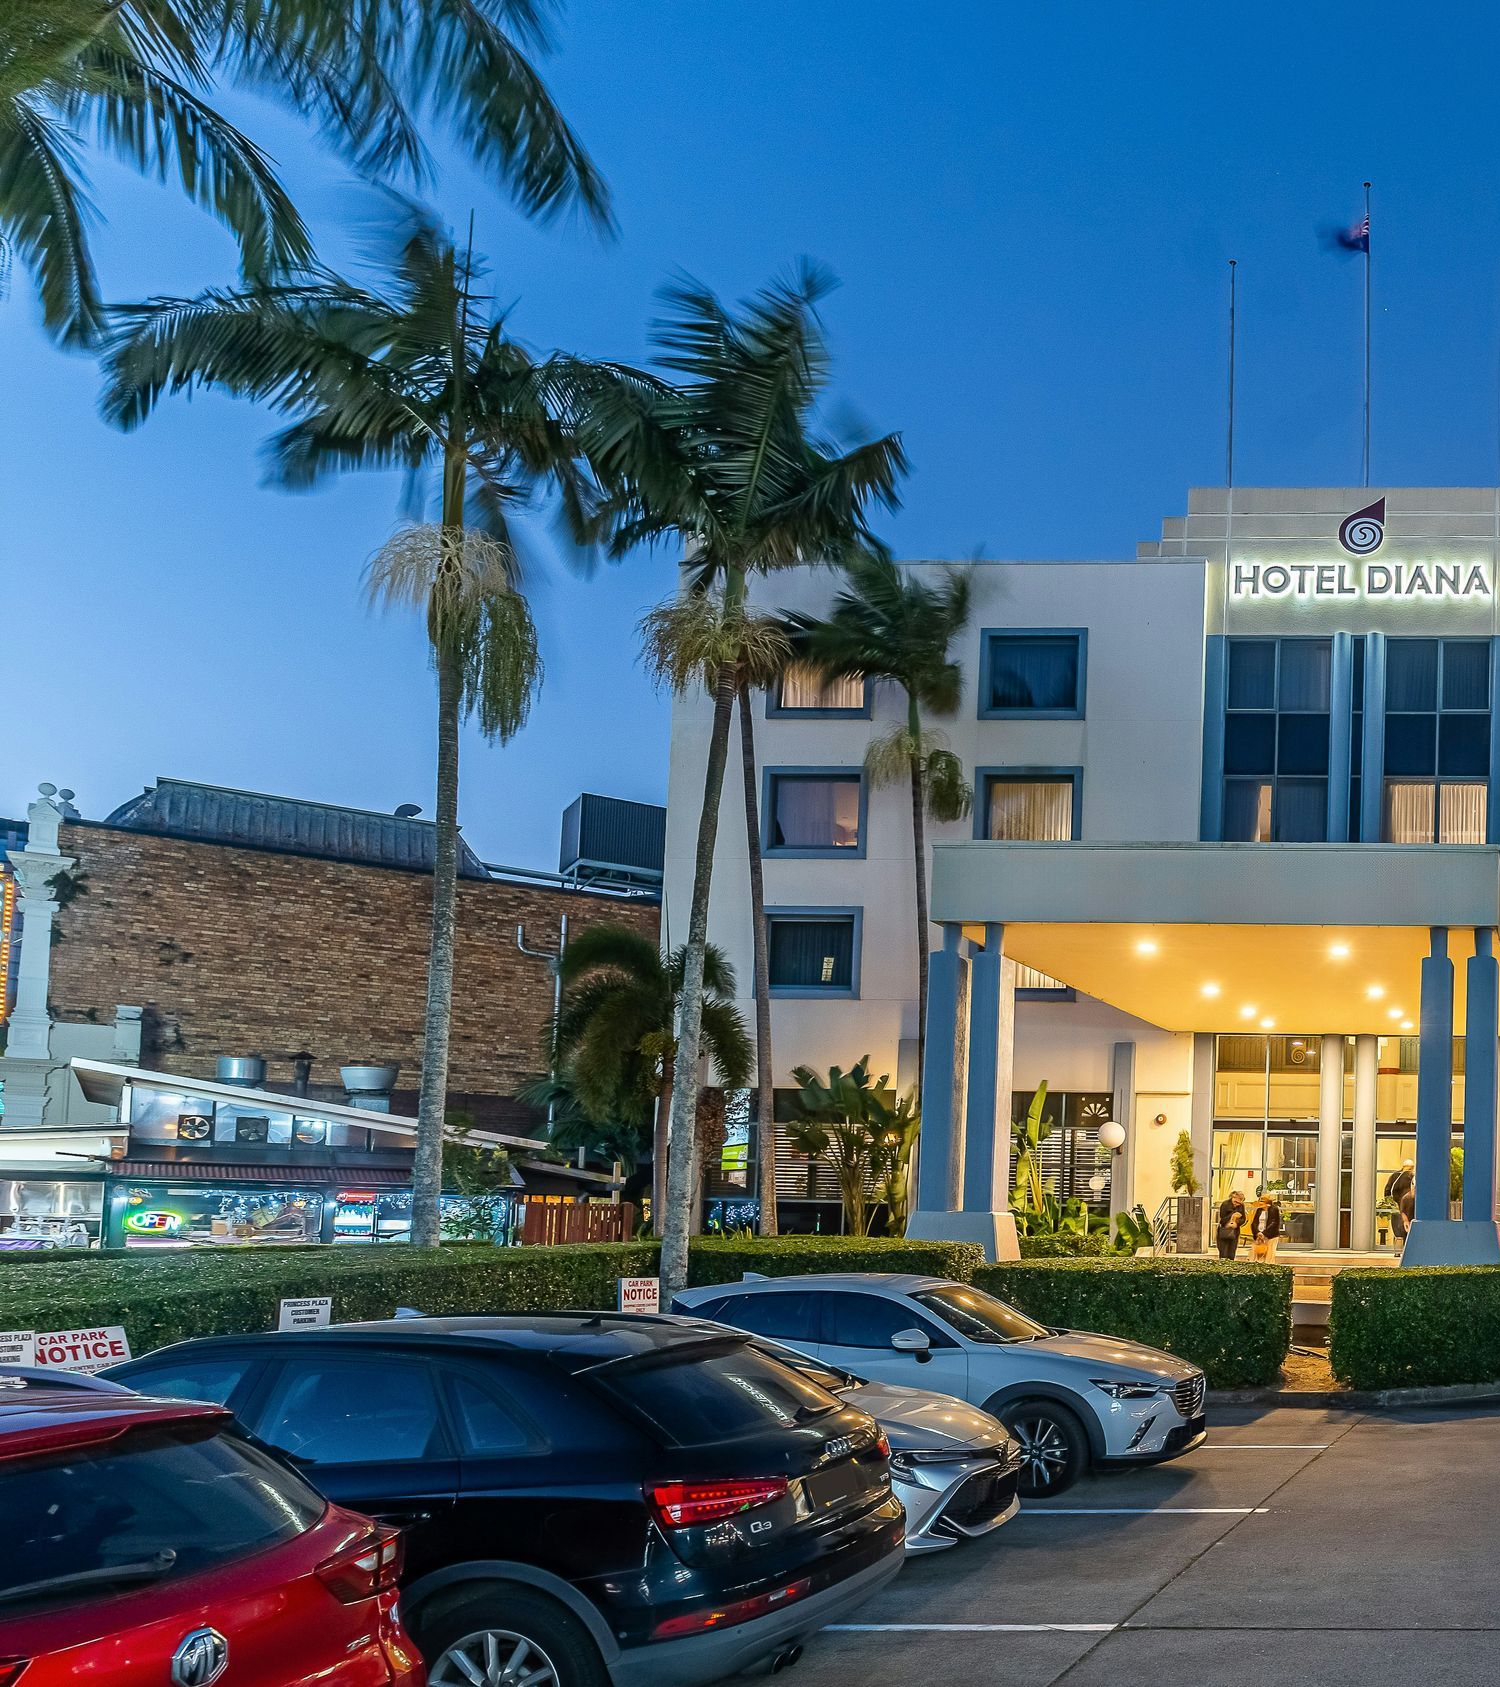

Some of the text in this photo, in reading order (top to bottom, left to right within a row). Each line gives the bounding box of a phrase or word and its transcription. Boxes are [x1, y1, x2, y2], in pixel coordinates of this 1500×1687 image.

[1234, 565, 1491, 594] HOTEL DIANA
[132, 1213, 181, 1231] OPEN
[624, 1288, 657, 1300] NOTICE
[38, 1331, 109, 1346] CAR PARK
[35, 1340, 125, 1365] NOTICE
[750, 1521, 773, 1534] Q3
[347, 1634, 371, 1650] ZS
